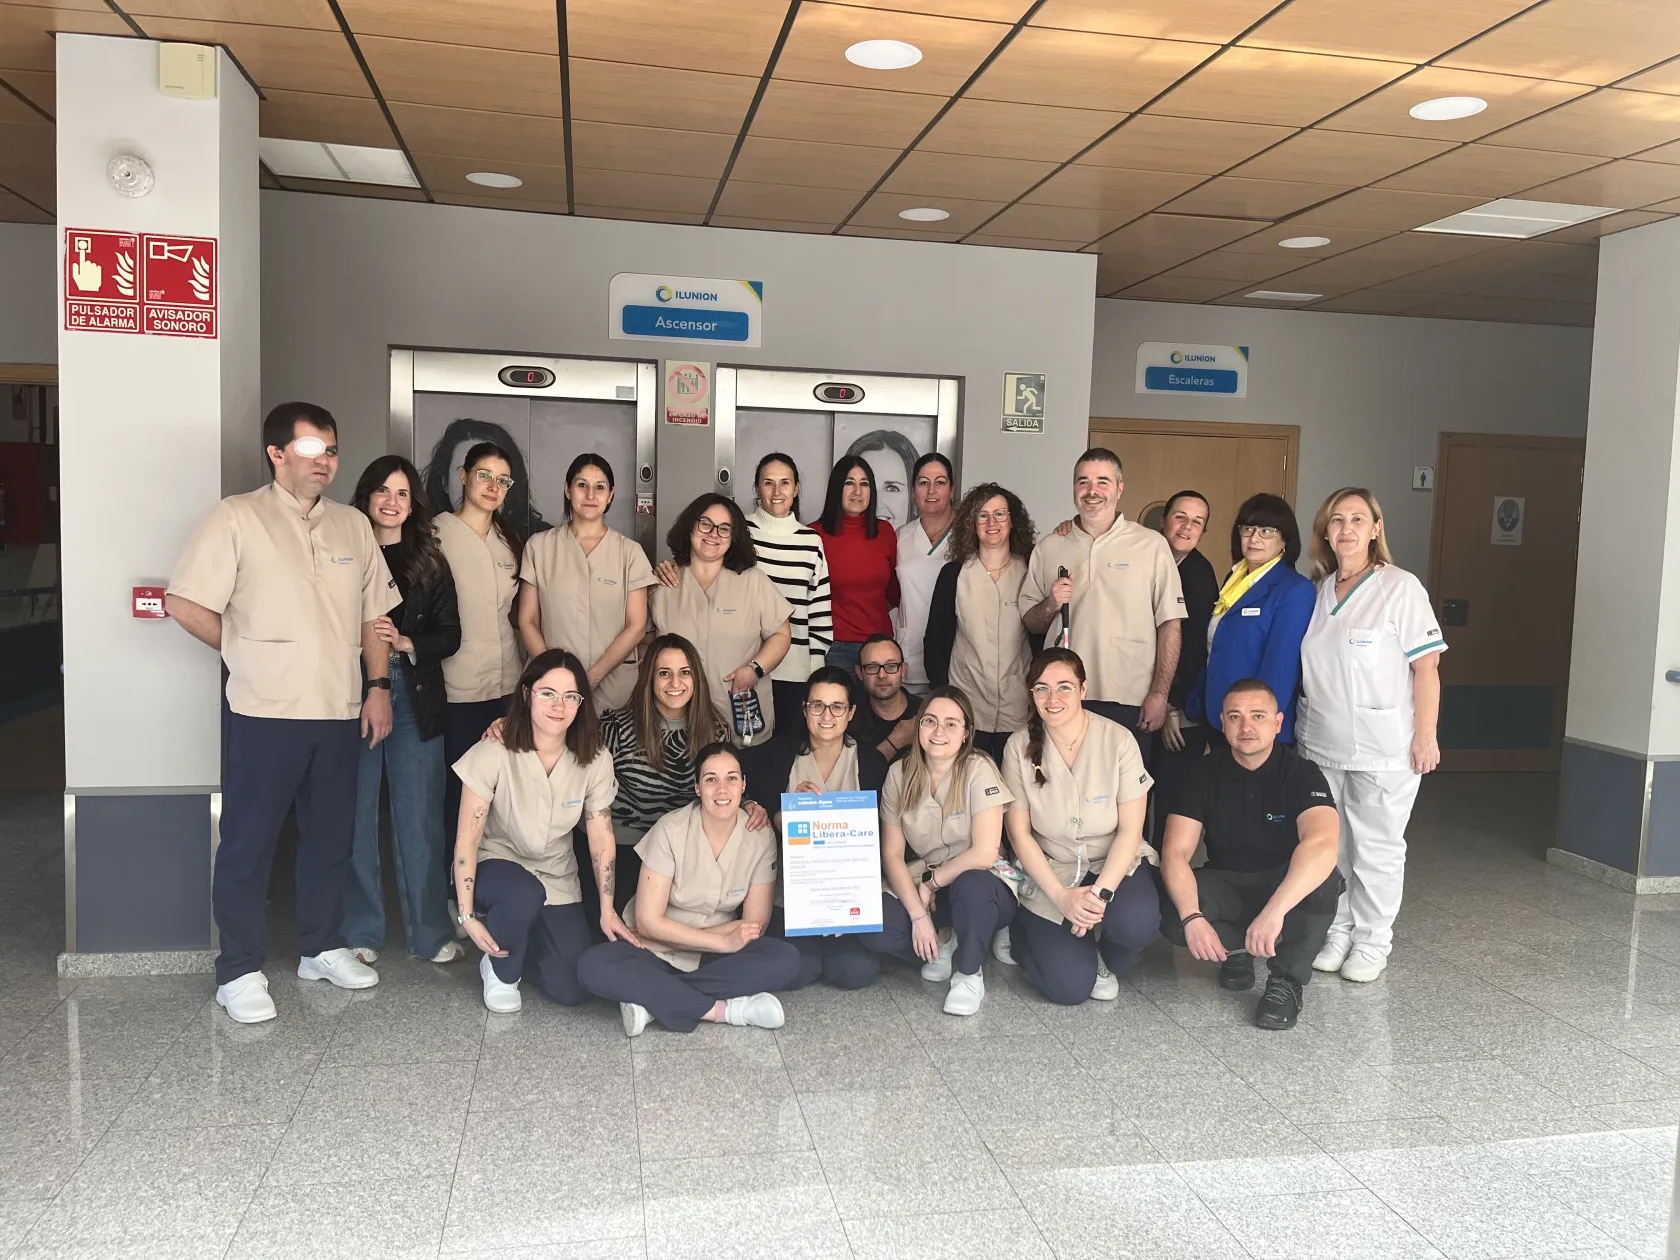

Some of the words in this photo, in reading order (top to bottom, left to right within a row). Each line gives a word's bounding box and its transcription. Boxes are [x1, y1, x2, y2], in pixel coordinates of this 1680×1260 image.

[675, 290, 718, 302] ILUNION
[71, 305, 135, 317] PULSADOR
[149, 309, 211, 321] AVISADOR
[71, 315, 88, 325] DE
[89, 316, 136, 329] ALARMA
[153, 319, 207, 332] SONORO
[655, 315, 718, 332] Ascensor
[1184, 354, 1216, 363] ILUNION
[1168, 374, 1215, 387] Escaleras
[1006, 418, 1039, 427] SALIDA
[812, 820, 849, 831] Norma
[812, 829, 874, 839] Libera-Care
